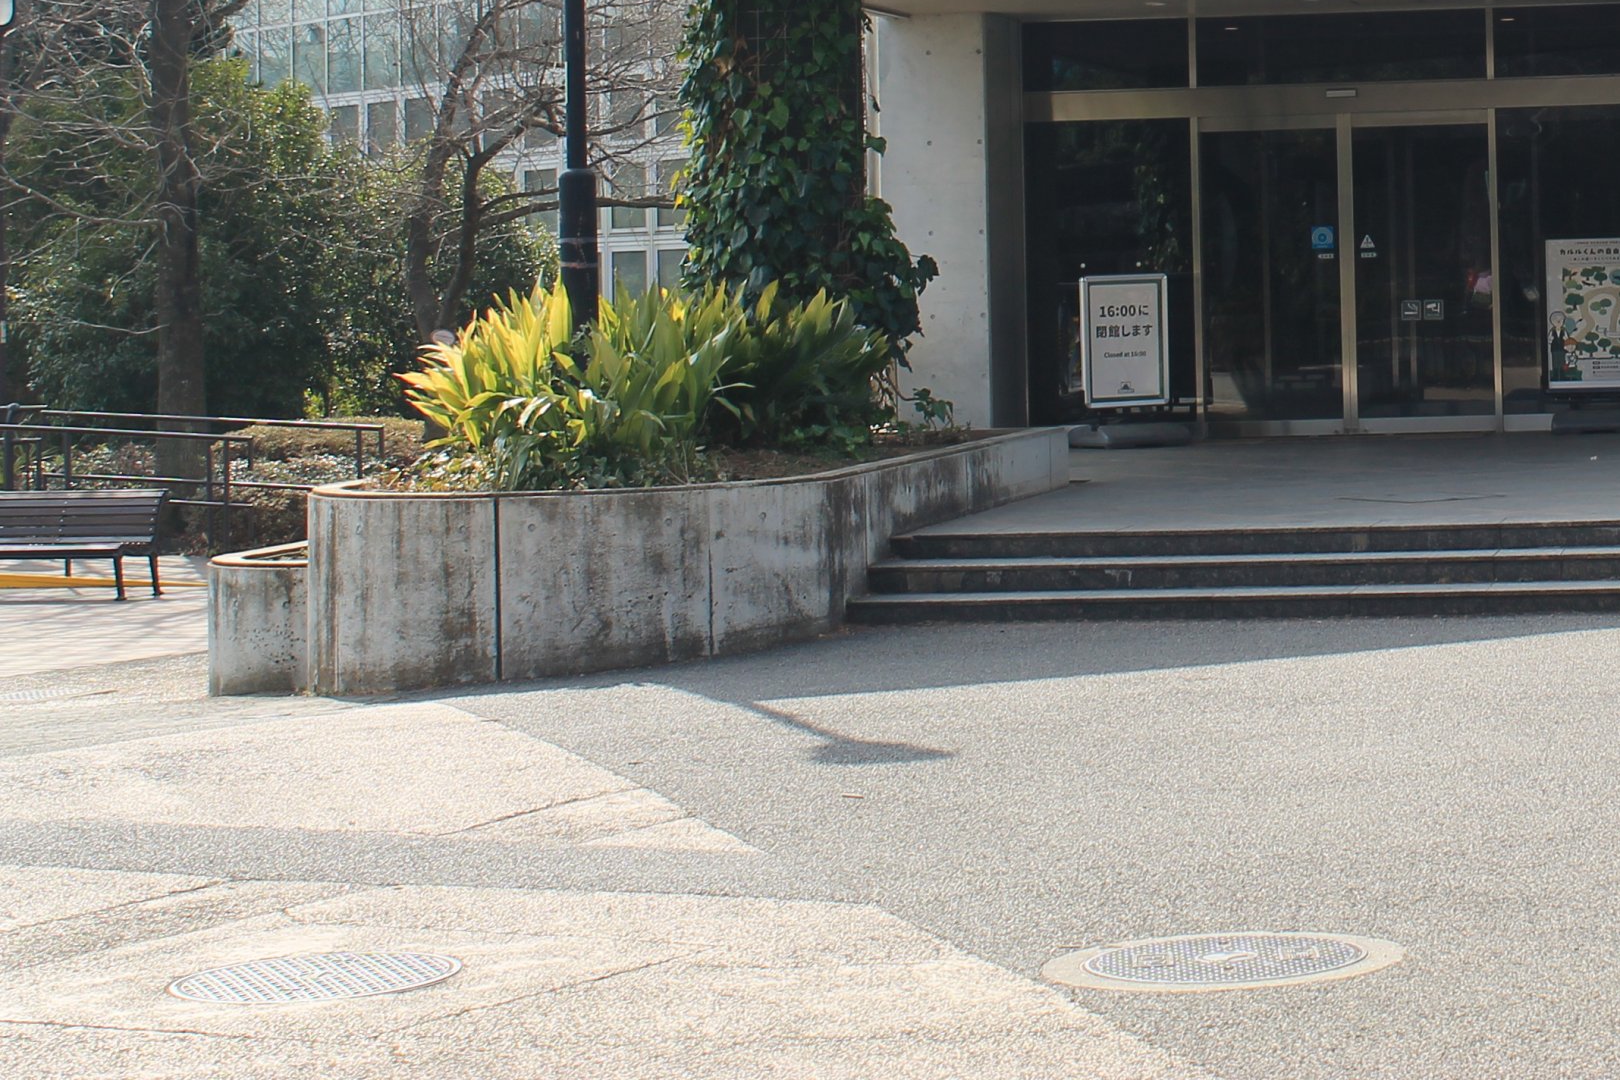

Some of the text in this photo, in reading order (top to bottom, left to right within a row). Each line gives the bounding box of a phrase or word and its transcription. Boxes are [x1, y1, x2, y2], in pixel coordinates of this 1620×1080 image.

[1096, 324, 1153, 338] 閉館します
[1104, 351, 1123, 359] Closed
